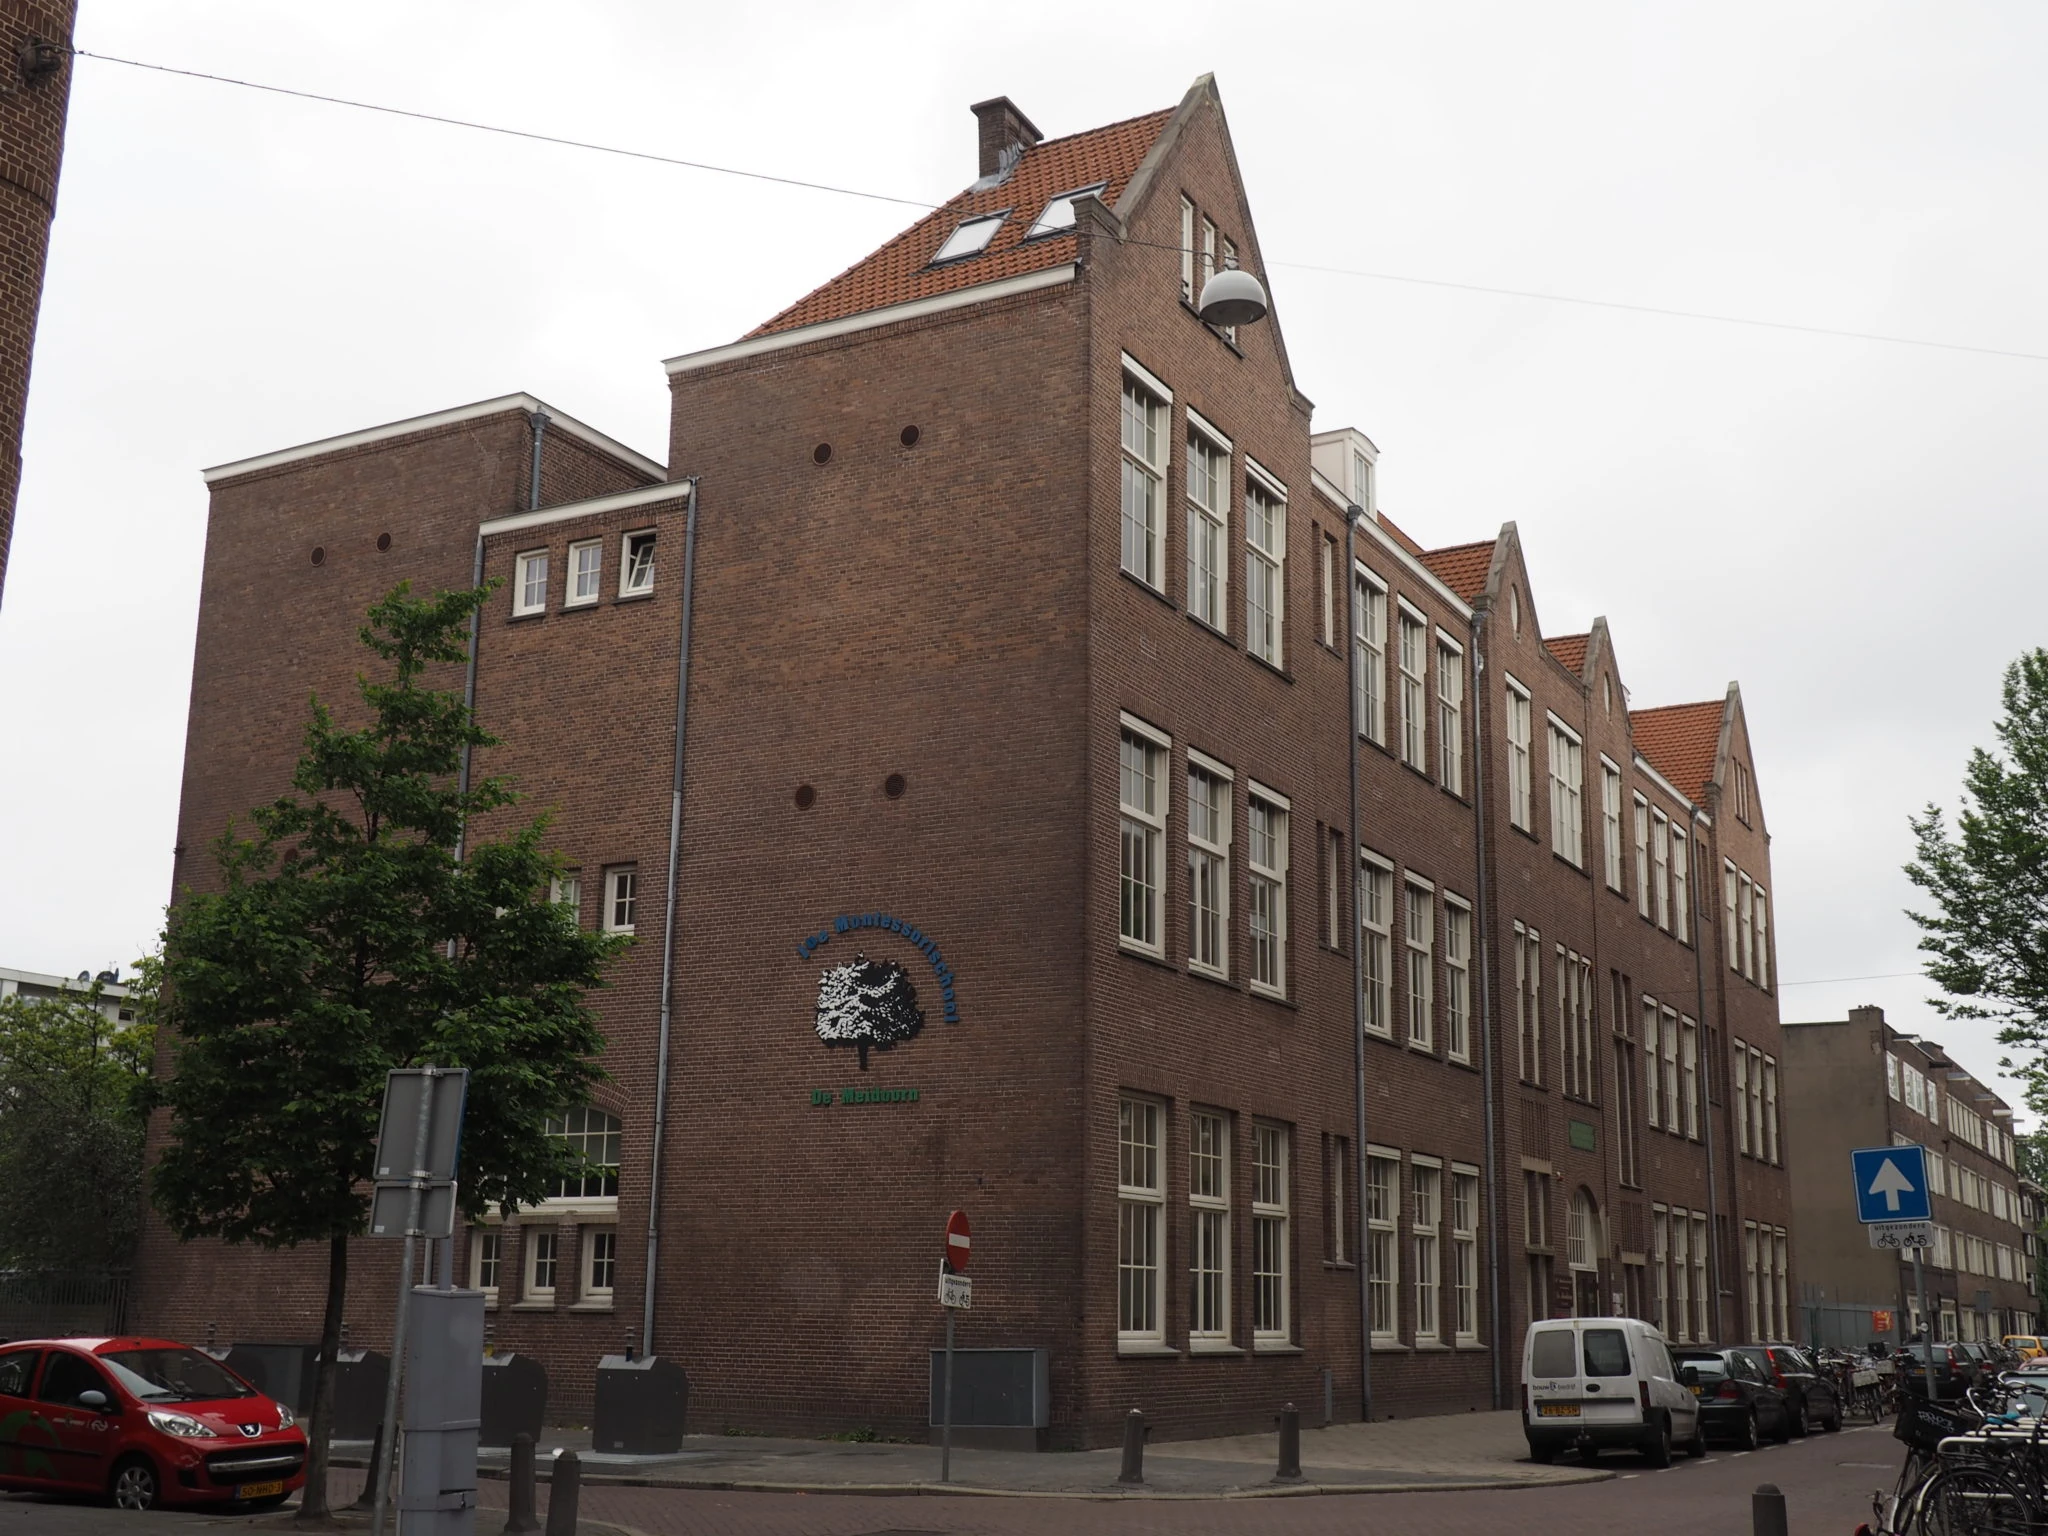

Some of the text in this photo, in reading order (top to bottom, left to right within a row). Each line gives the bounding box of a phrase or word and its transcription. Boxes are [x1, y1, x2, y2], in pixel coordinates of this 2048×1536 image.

[833, 911, 961, 1023] Montessorischool
[811, 1086, 920, 1105] De Meidoorn
[1874, 1223, 1926, 1232] uitgezonderd
